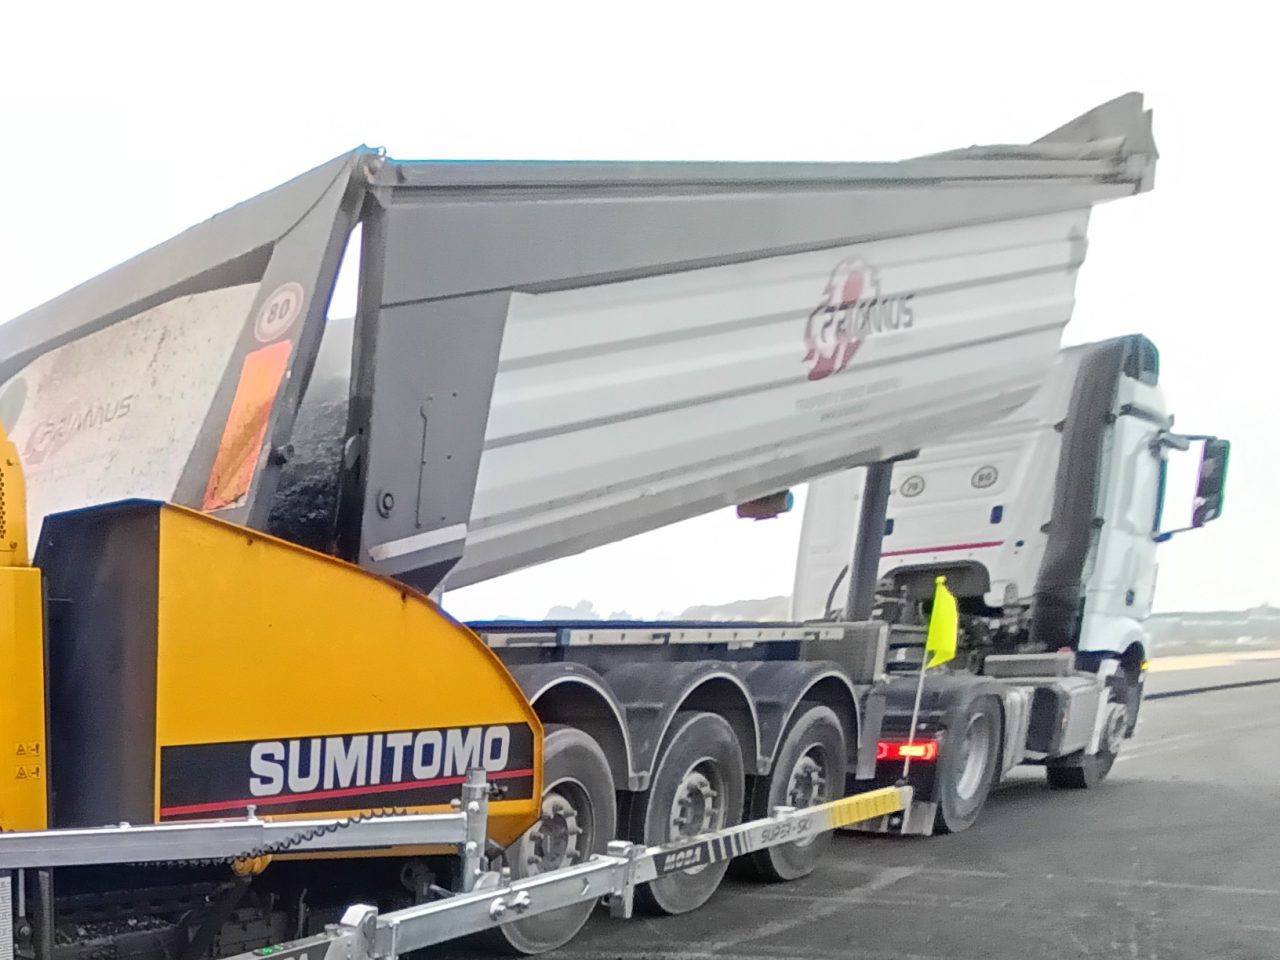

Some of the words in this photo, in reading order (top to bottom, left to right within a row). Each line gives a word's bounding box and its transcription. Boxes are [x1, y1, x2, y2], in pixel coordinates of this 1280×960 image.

[267, 299, 290, 324] 80
[249, 725, 511, 797] SUMITOMO
[663, 846, 702, 872] MOBA
